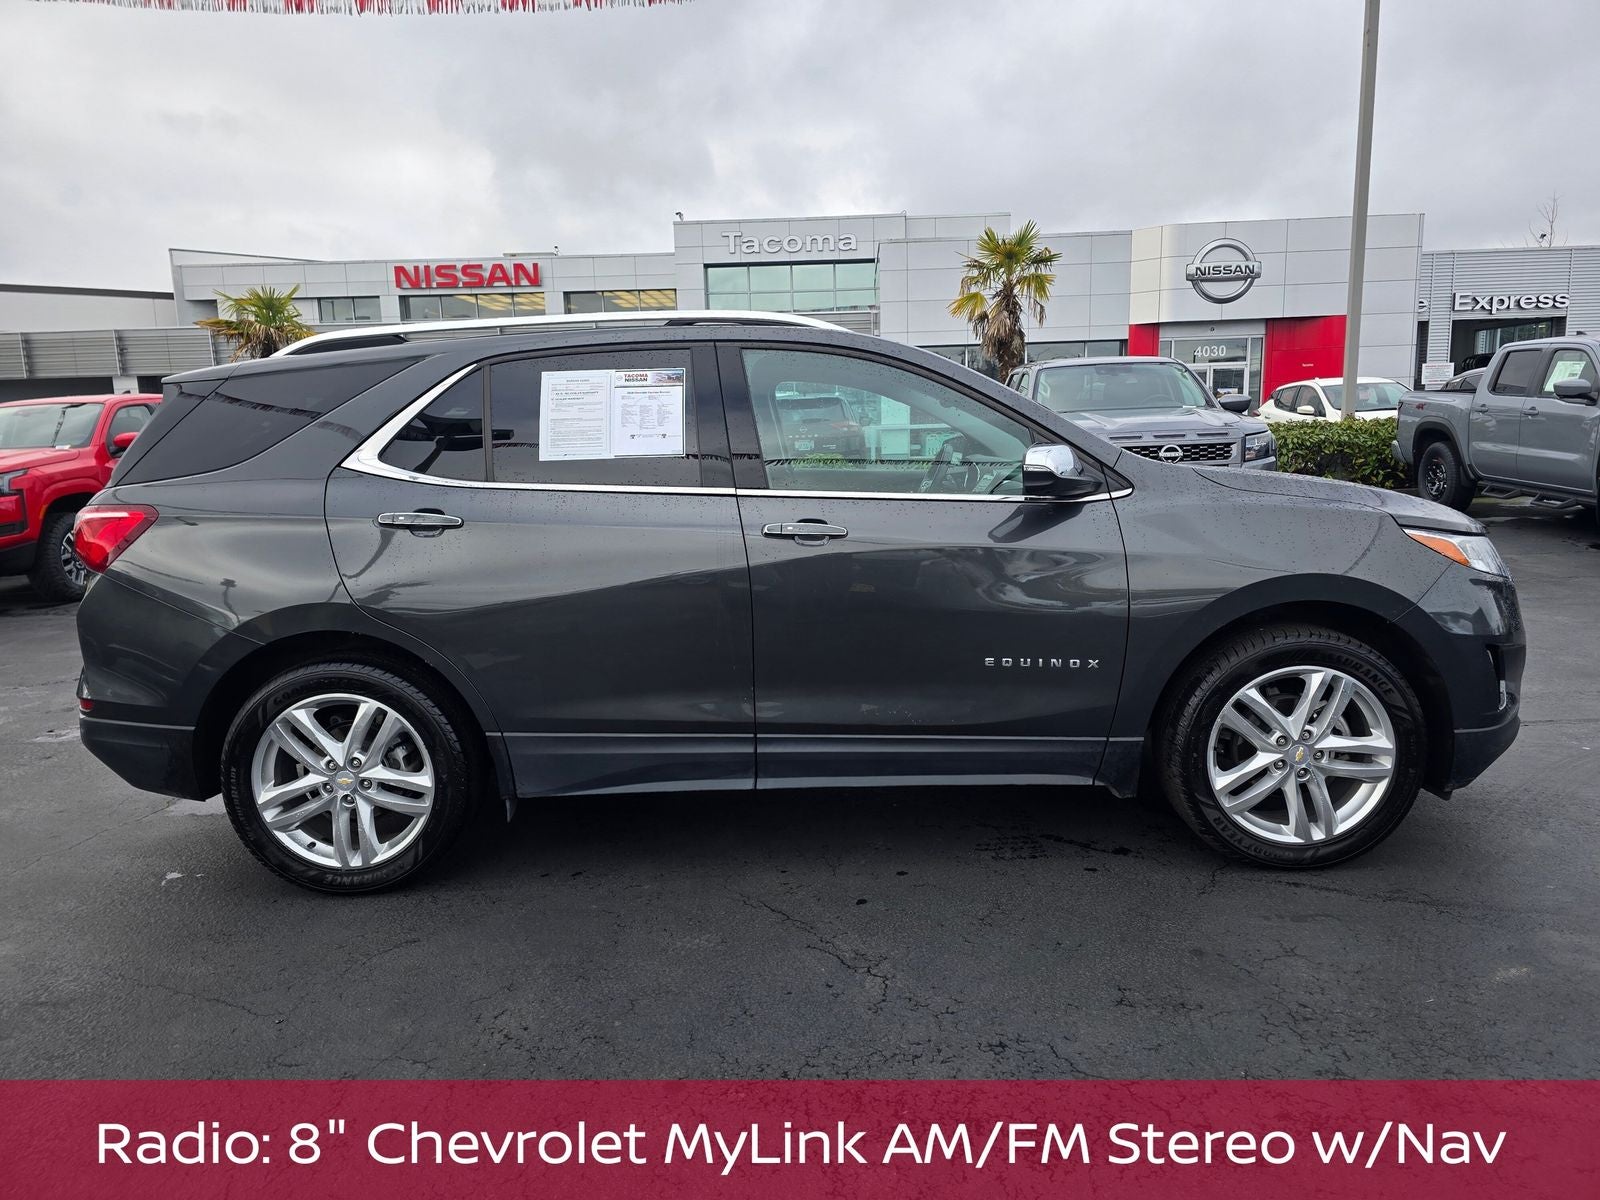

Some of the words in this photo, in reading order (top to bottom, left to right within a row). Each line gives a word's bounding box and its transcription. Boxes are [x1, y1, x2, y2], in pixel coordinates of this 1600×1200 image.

[721, 230, 858, 254] Tacoma
[393, 262, 542, 289] NISSAN
[1194, 264, 1255, 278] NISSAN
[1453, 291, 1570, 316] Express
[1194, 345, 1227, 358] 4030
[984, 657, 1100, 669] EQUINOX
